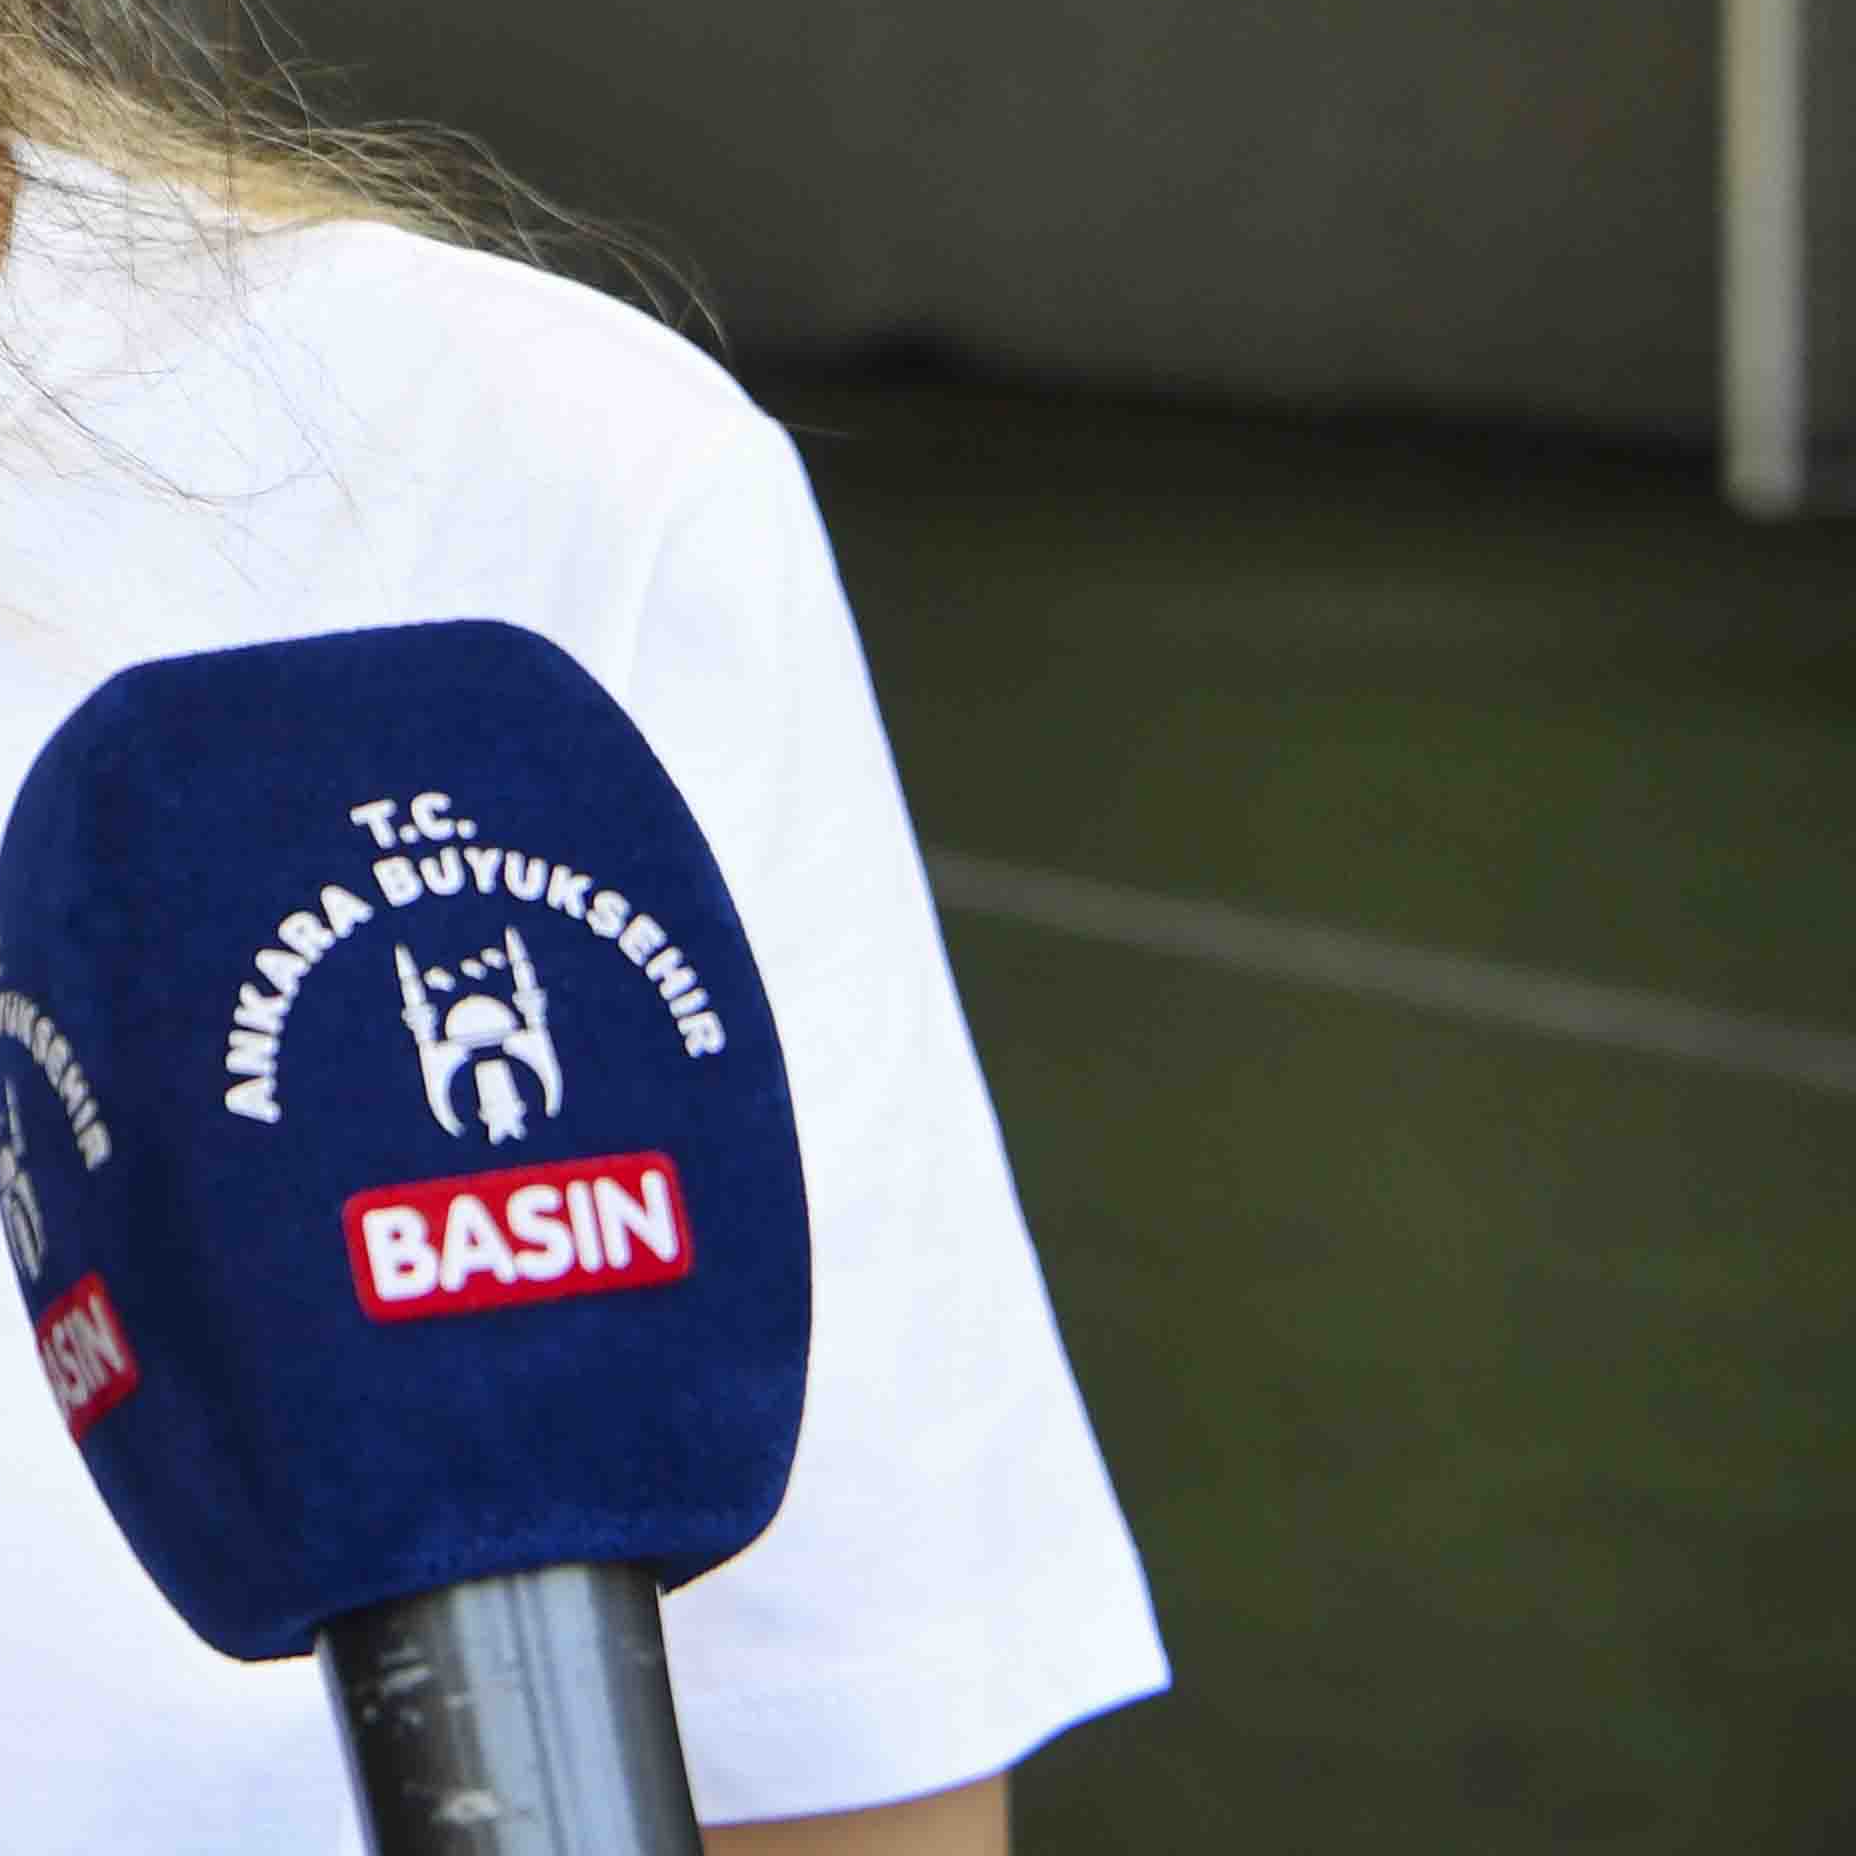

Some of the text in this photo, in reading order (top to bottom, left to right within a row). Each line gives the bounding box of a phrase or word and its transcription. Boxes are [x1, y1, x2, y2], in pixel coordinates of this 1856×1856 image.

[350, 791, 477, 848] T.C.
[225, 884, 374, 1124] ANKARA
[361, 1169, 681, 1302] BASIN
